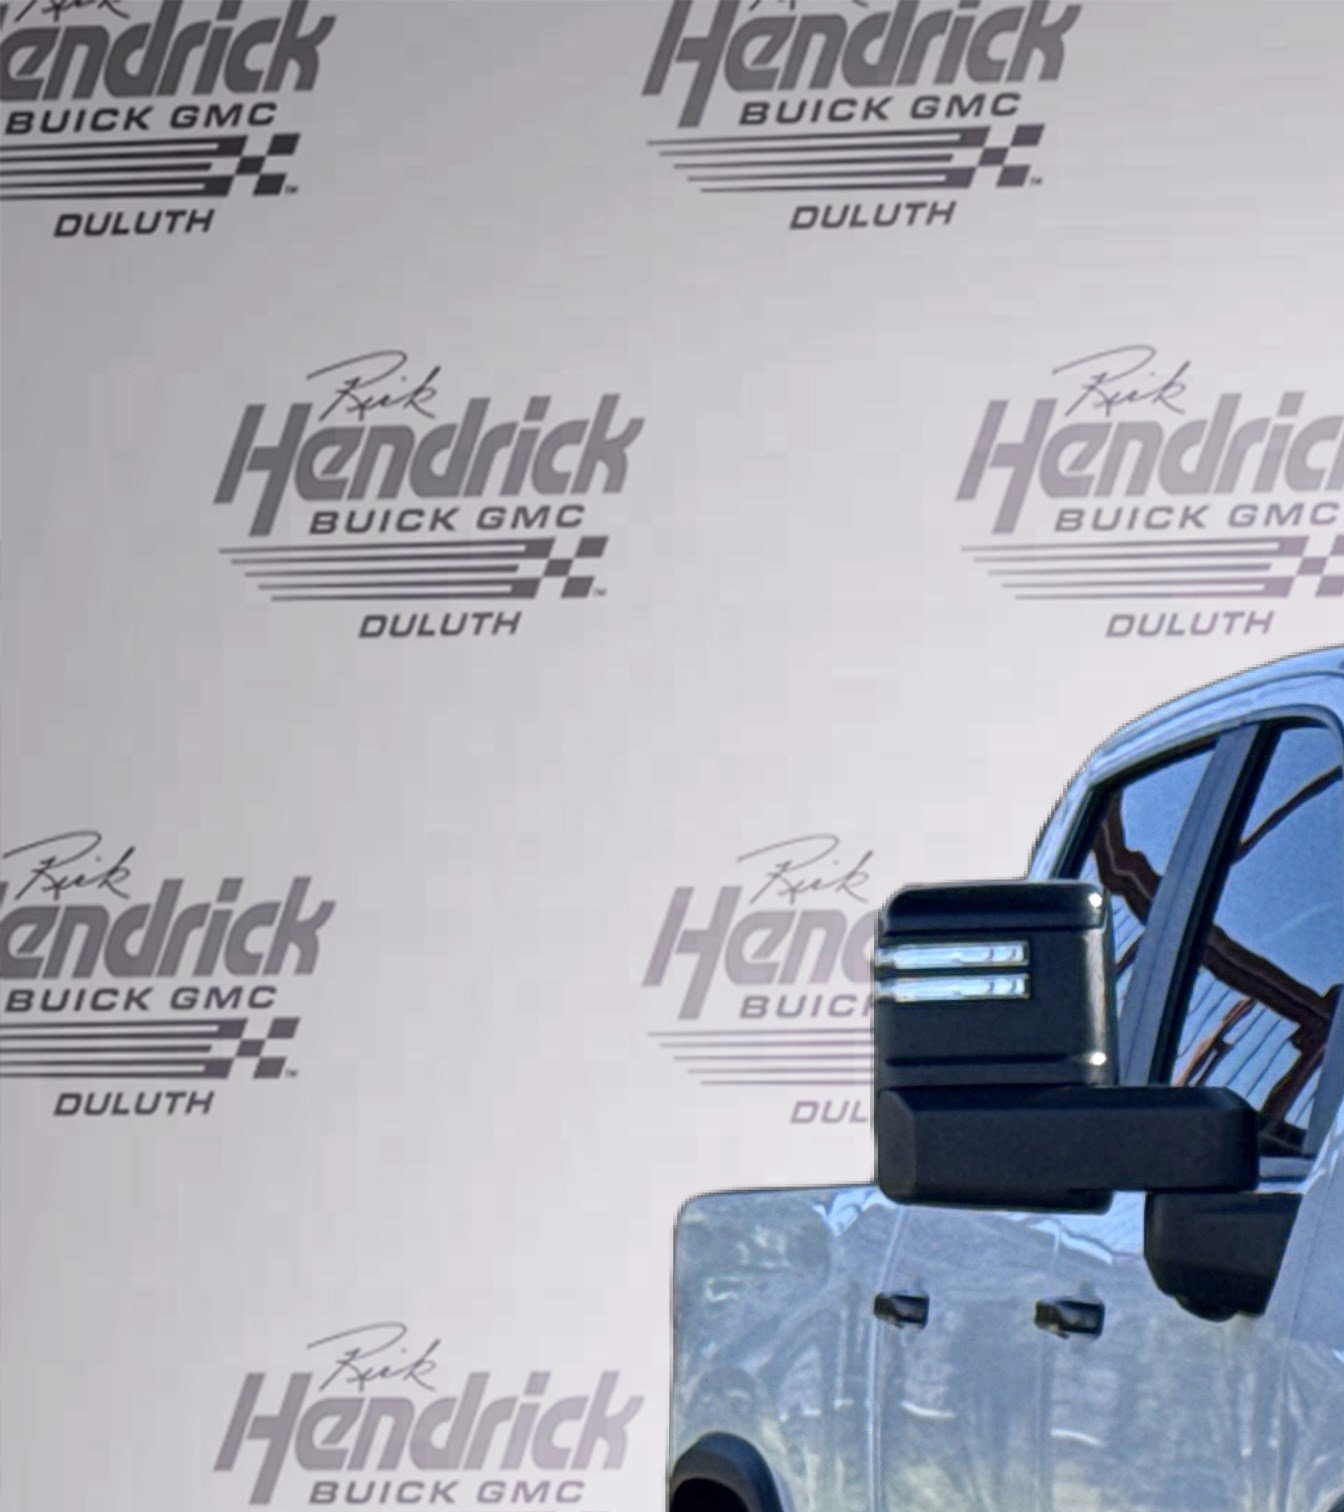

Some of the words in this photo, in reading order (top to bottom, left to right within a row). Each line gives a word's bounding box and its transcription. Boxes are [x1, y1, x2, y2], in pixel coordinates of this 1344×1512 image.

[0, 0, 336, 101] endrick
[641, 0, 1082, 128] Hendrick
[5, 106, 153, 135] BUICK
[170, 102, 277, 129] GMC
[739, 97, 892, 126] BUICK
[910, 92, 1021, 119] GMC
[54, 209, 215, 237] DULUTH
[790, 201, 956, 230] DULUTH
[212, 393, 645, 537] Hendrick
[309, 508, 458, 534] BUICK
[476, 504, 585, 530] GMC
[1054, 506, 1209, 532] BUICK
[1228, 502, 1340, 528] GMC
[358, 612, 521, 638] DULUTH
[1106, 611, 1274, 638] DULUTH
[0, 876, 336, 980] endrick
[5, 987, 152, 1013] BUICK
[170, 986, 276, 1010] GMC
[740, 994, 873, 1019] BUIC
[54, 1091, 214, 1116] DULUTH
[790, 1100, 868, 1124] DUL
[212, 1371, 645, 1506] Hendrick
[309, 1481, 458, 1505] BUICK
[476, 1480, 584, 1504] GMC
